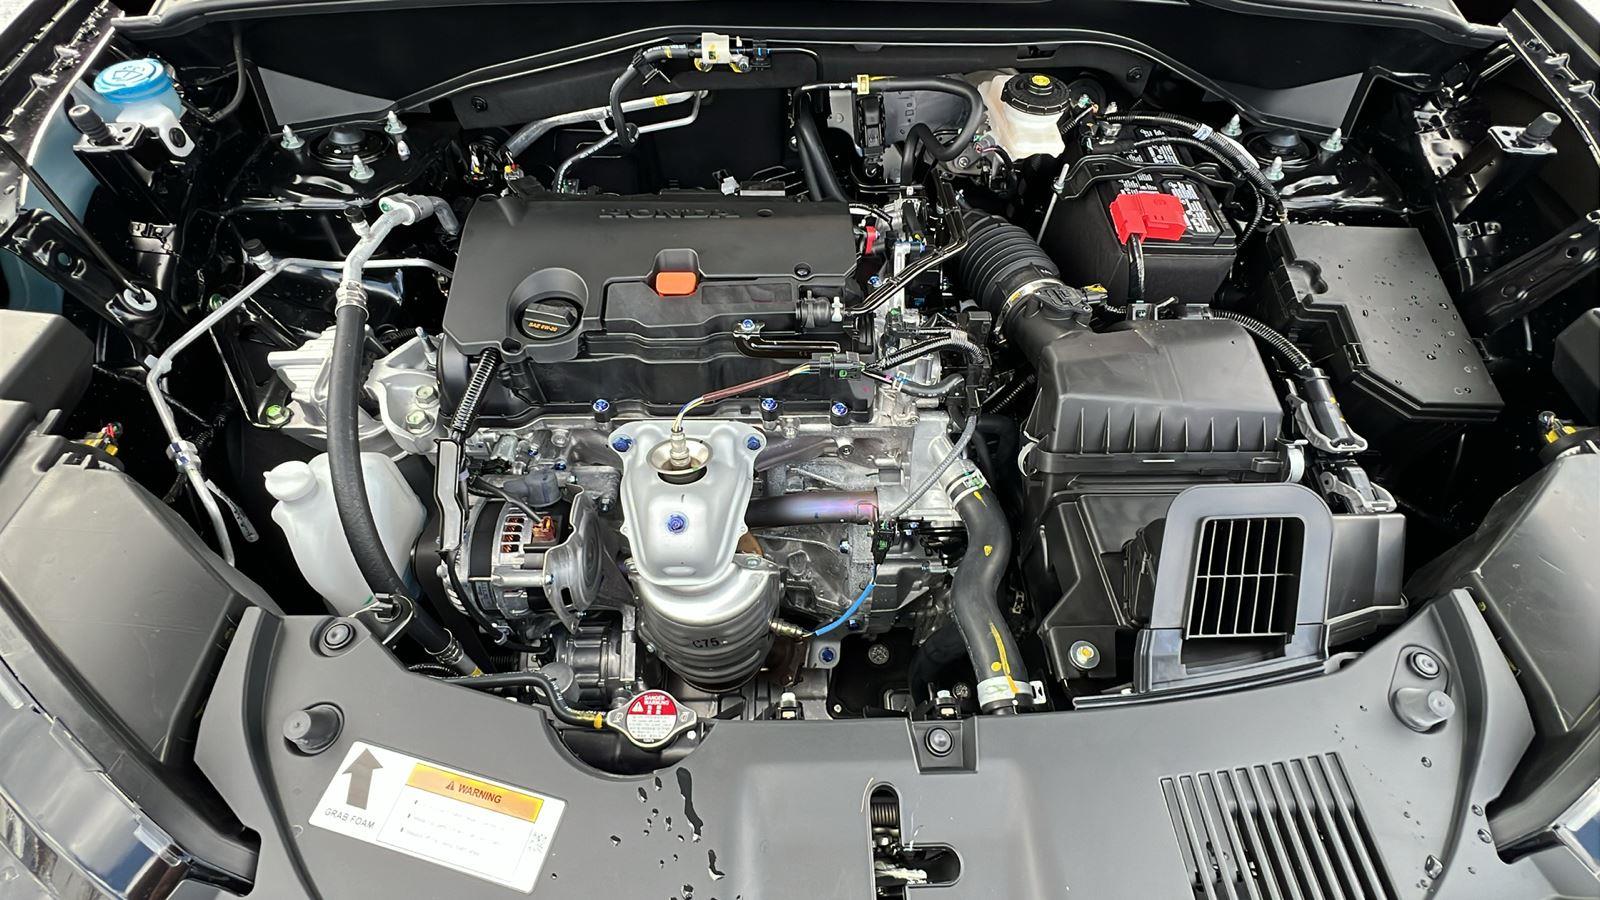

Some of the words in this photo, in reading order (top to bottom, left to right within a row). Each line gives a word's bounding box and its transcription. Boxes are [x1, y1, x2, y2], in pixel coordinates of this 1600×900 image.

[599, 208, 740, 219] HONDA
[458, 783, 502, 804] WARNING
[324, 807, 350, 822] GRAB
[350, 815, 376, 829] FOAM
